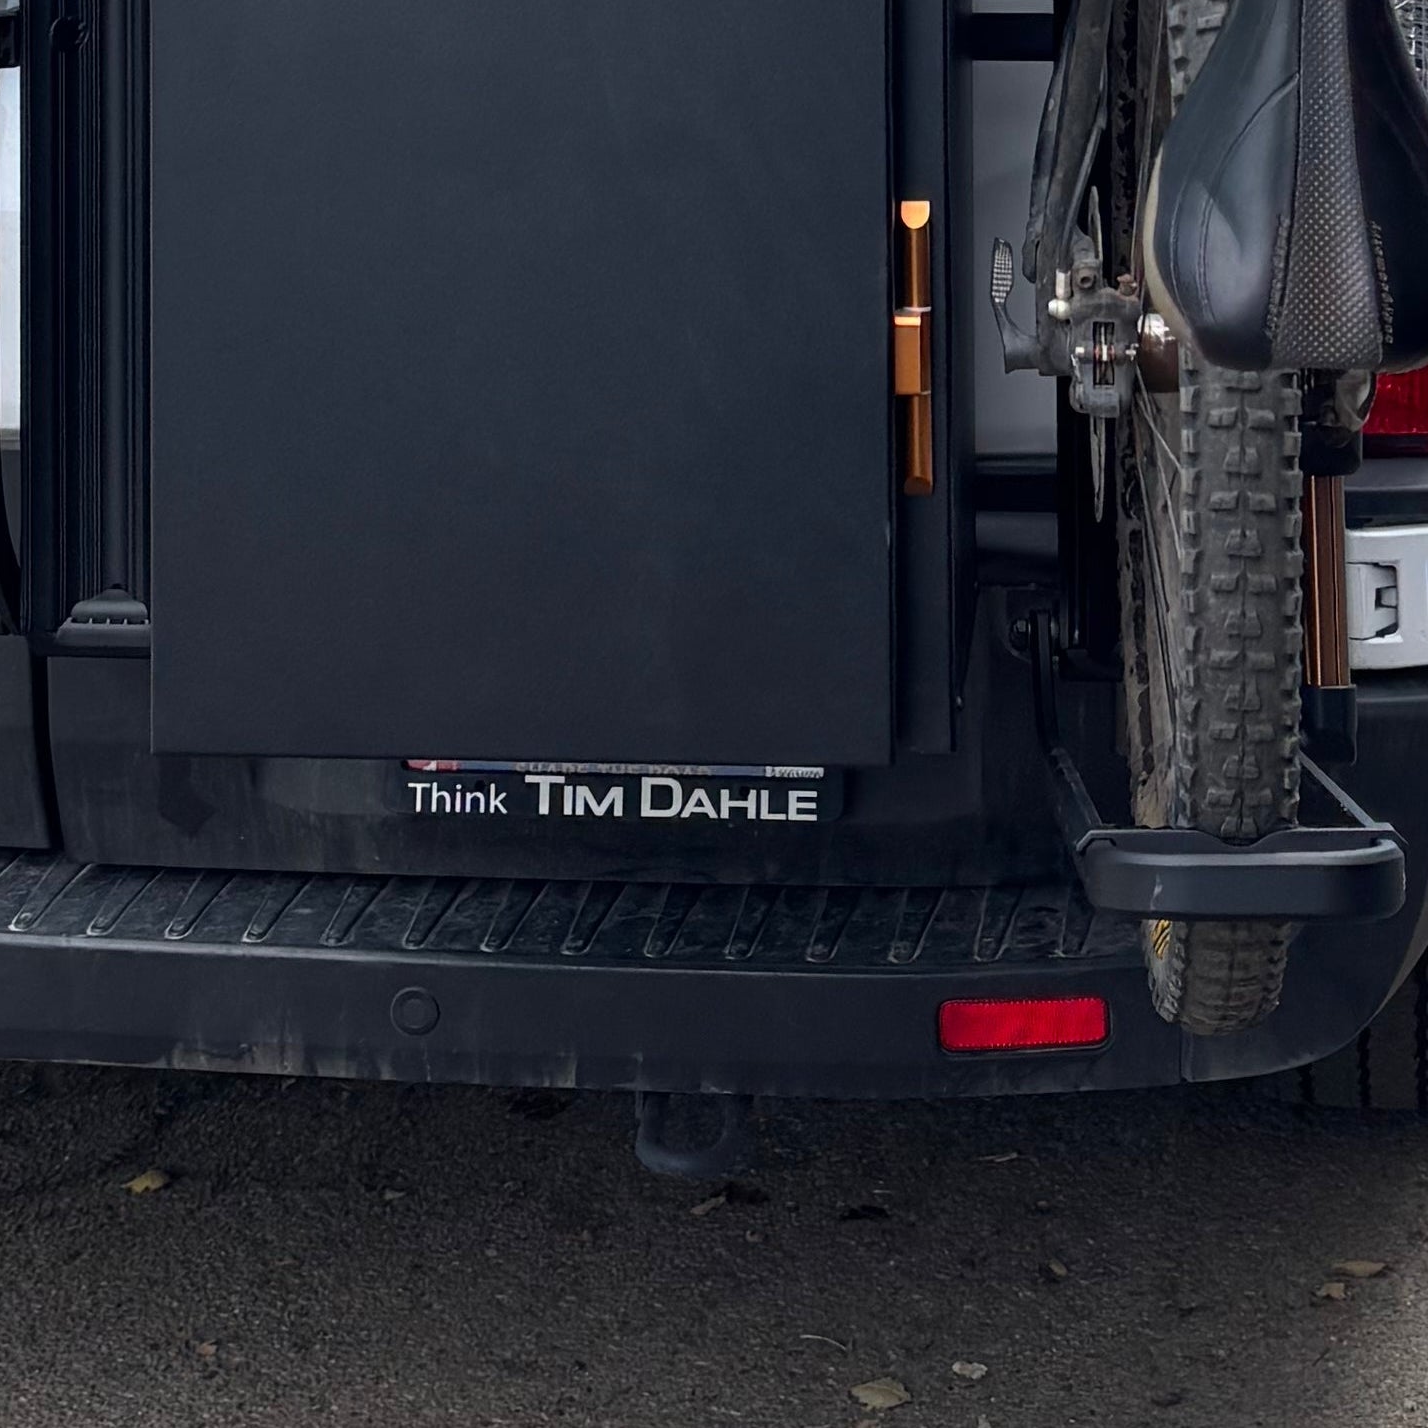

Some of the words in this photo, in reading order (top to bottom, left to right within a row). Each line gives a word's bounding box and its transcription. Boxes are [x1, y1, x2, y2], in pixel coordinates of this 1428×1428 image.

[408, 781, 508, 816] Think
[524, 774, 624, 818] TIM
[640, 776, 818, 822] DAHLE
